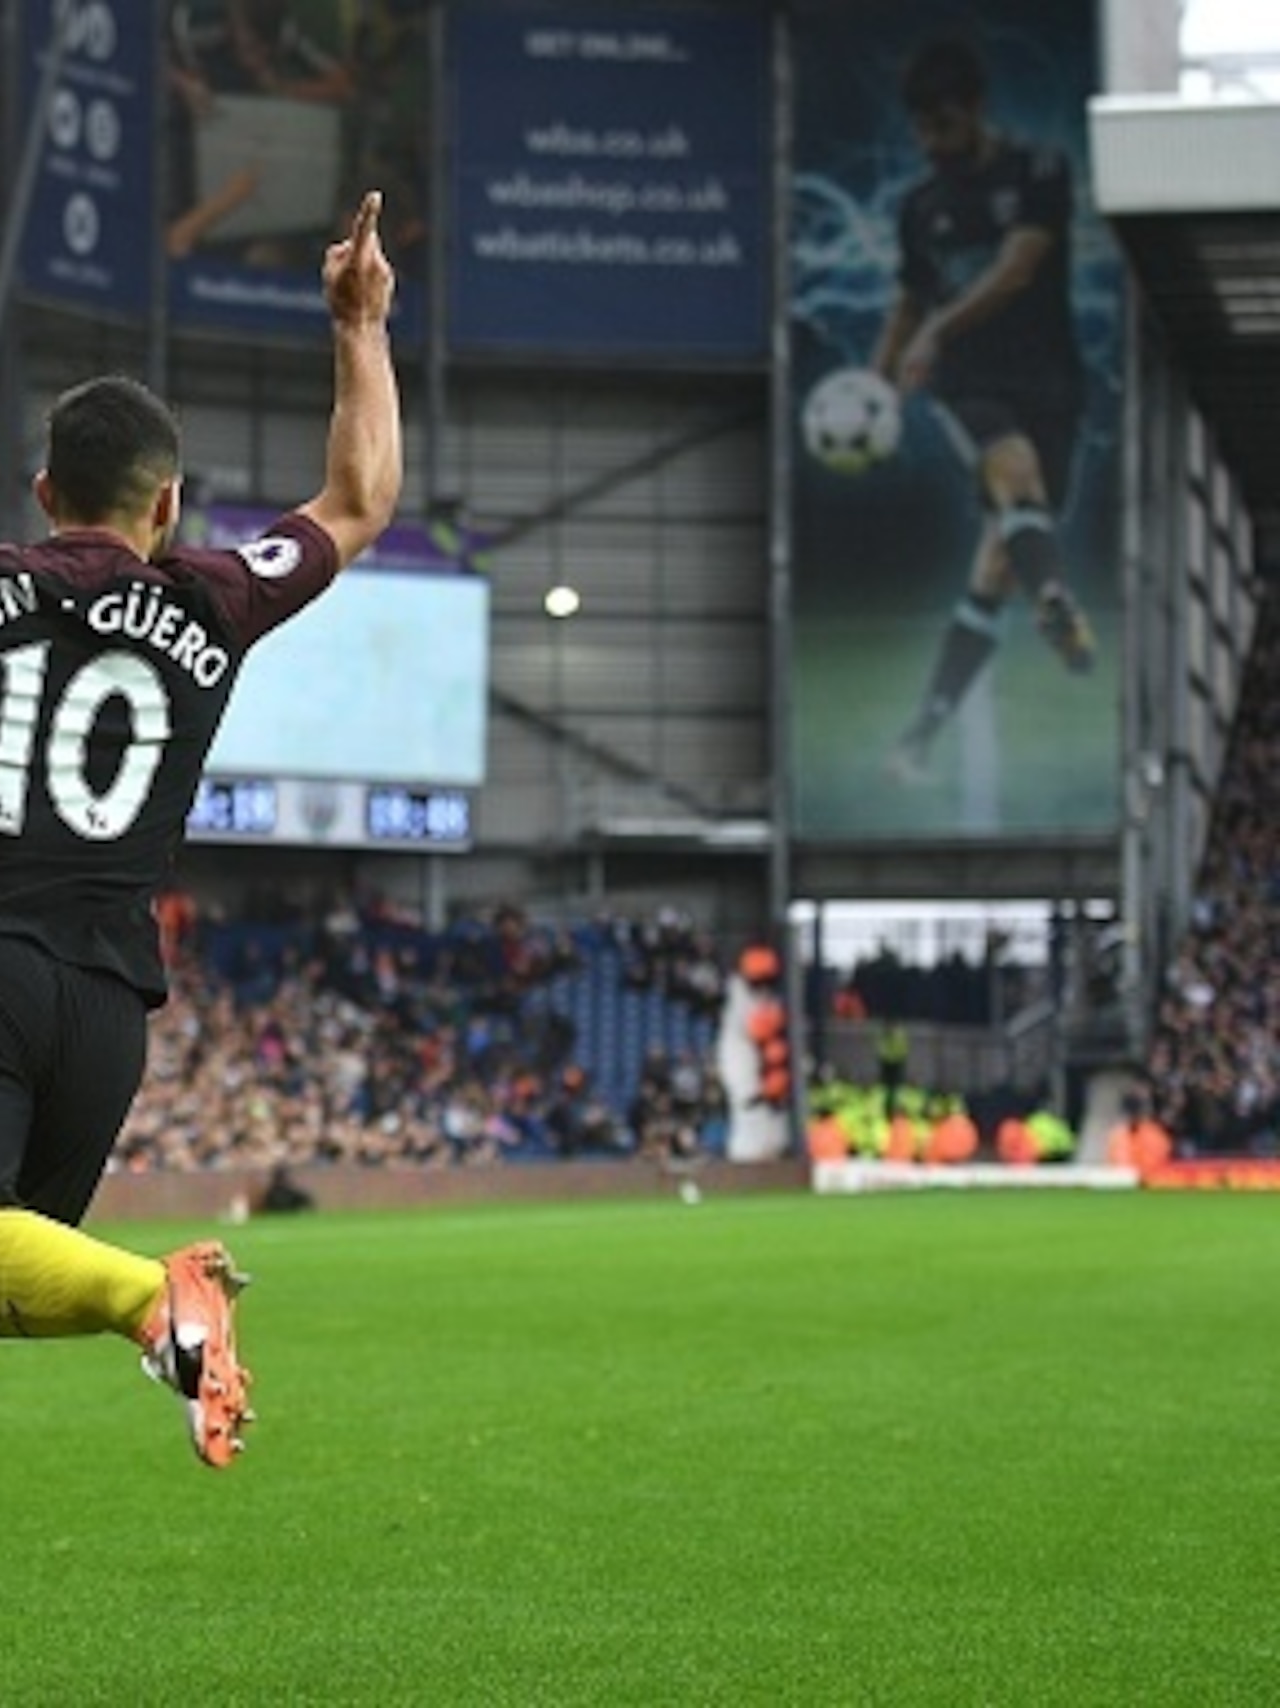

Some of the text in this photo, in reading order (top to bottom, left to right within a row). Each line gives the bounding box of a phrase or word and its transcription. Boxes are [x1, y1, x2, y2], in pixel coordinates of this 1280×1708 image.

[524, 121, 691, 157] wba.co.uk
[486, 170, 729, 217] wbashop.co.uk
[473, 225, 742, 266] wbatickets.co.uk
[61, 581, 229, 688] GÜERO
